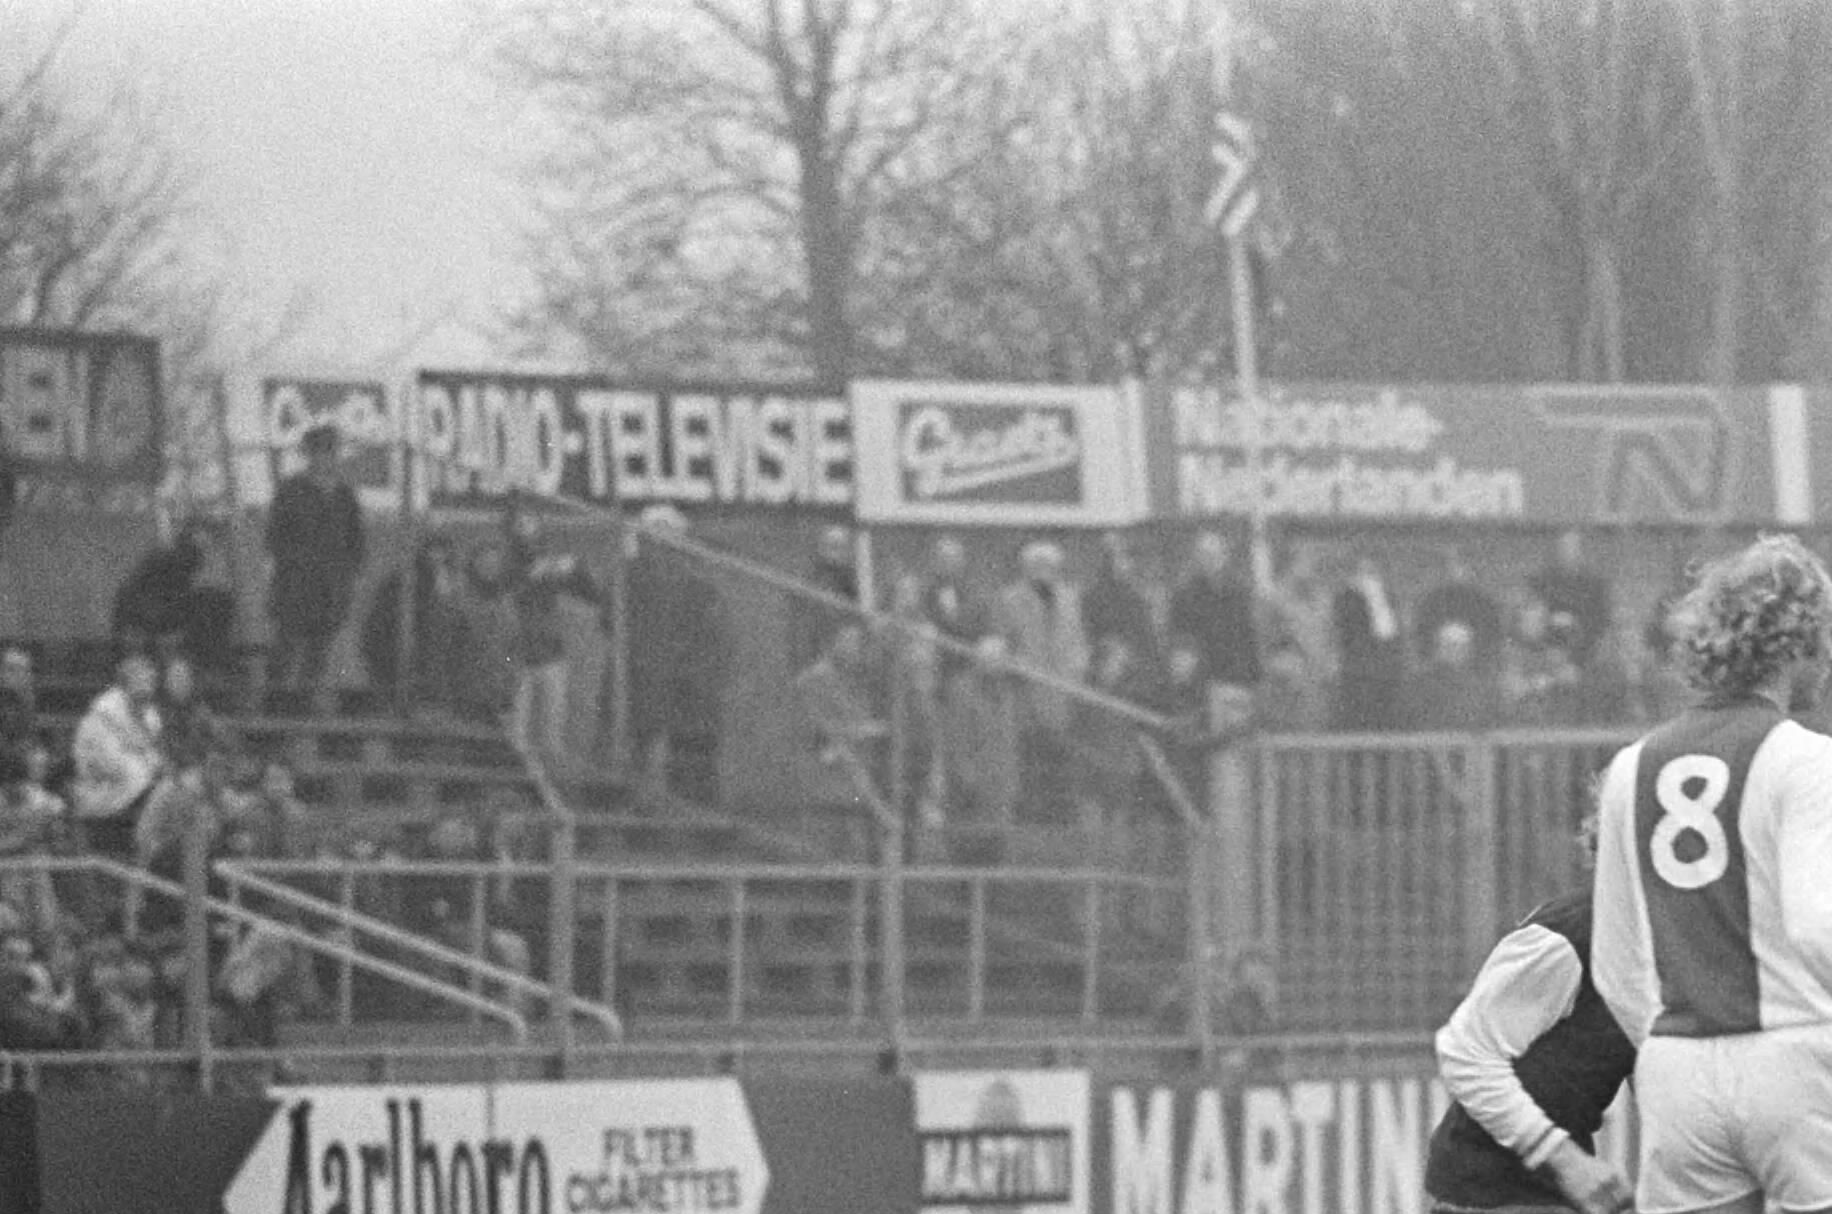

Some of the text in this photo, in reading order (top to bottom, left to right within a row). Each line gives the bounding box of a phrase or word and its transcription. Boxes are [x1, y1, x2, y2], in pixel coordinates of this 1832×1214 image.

[406, 385, 850, 502] RADIO-TELEVISIE
[1650, 753, 1730, 889] 8
[602, 1125, 697, 1168] FILTER
[924, 1136, 1065, 1198] MARTINI
[566, 1166, 740, 1214] CIGARETTES
